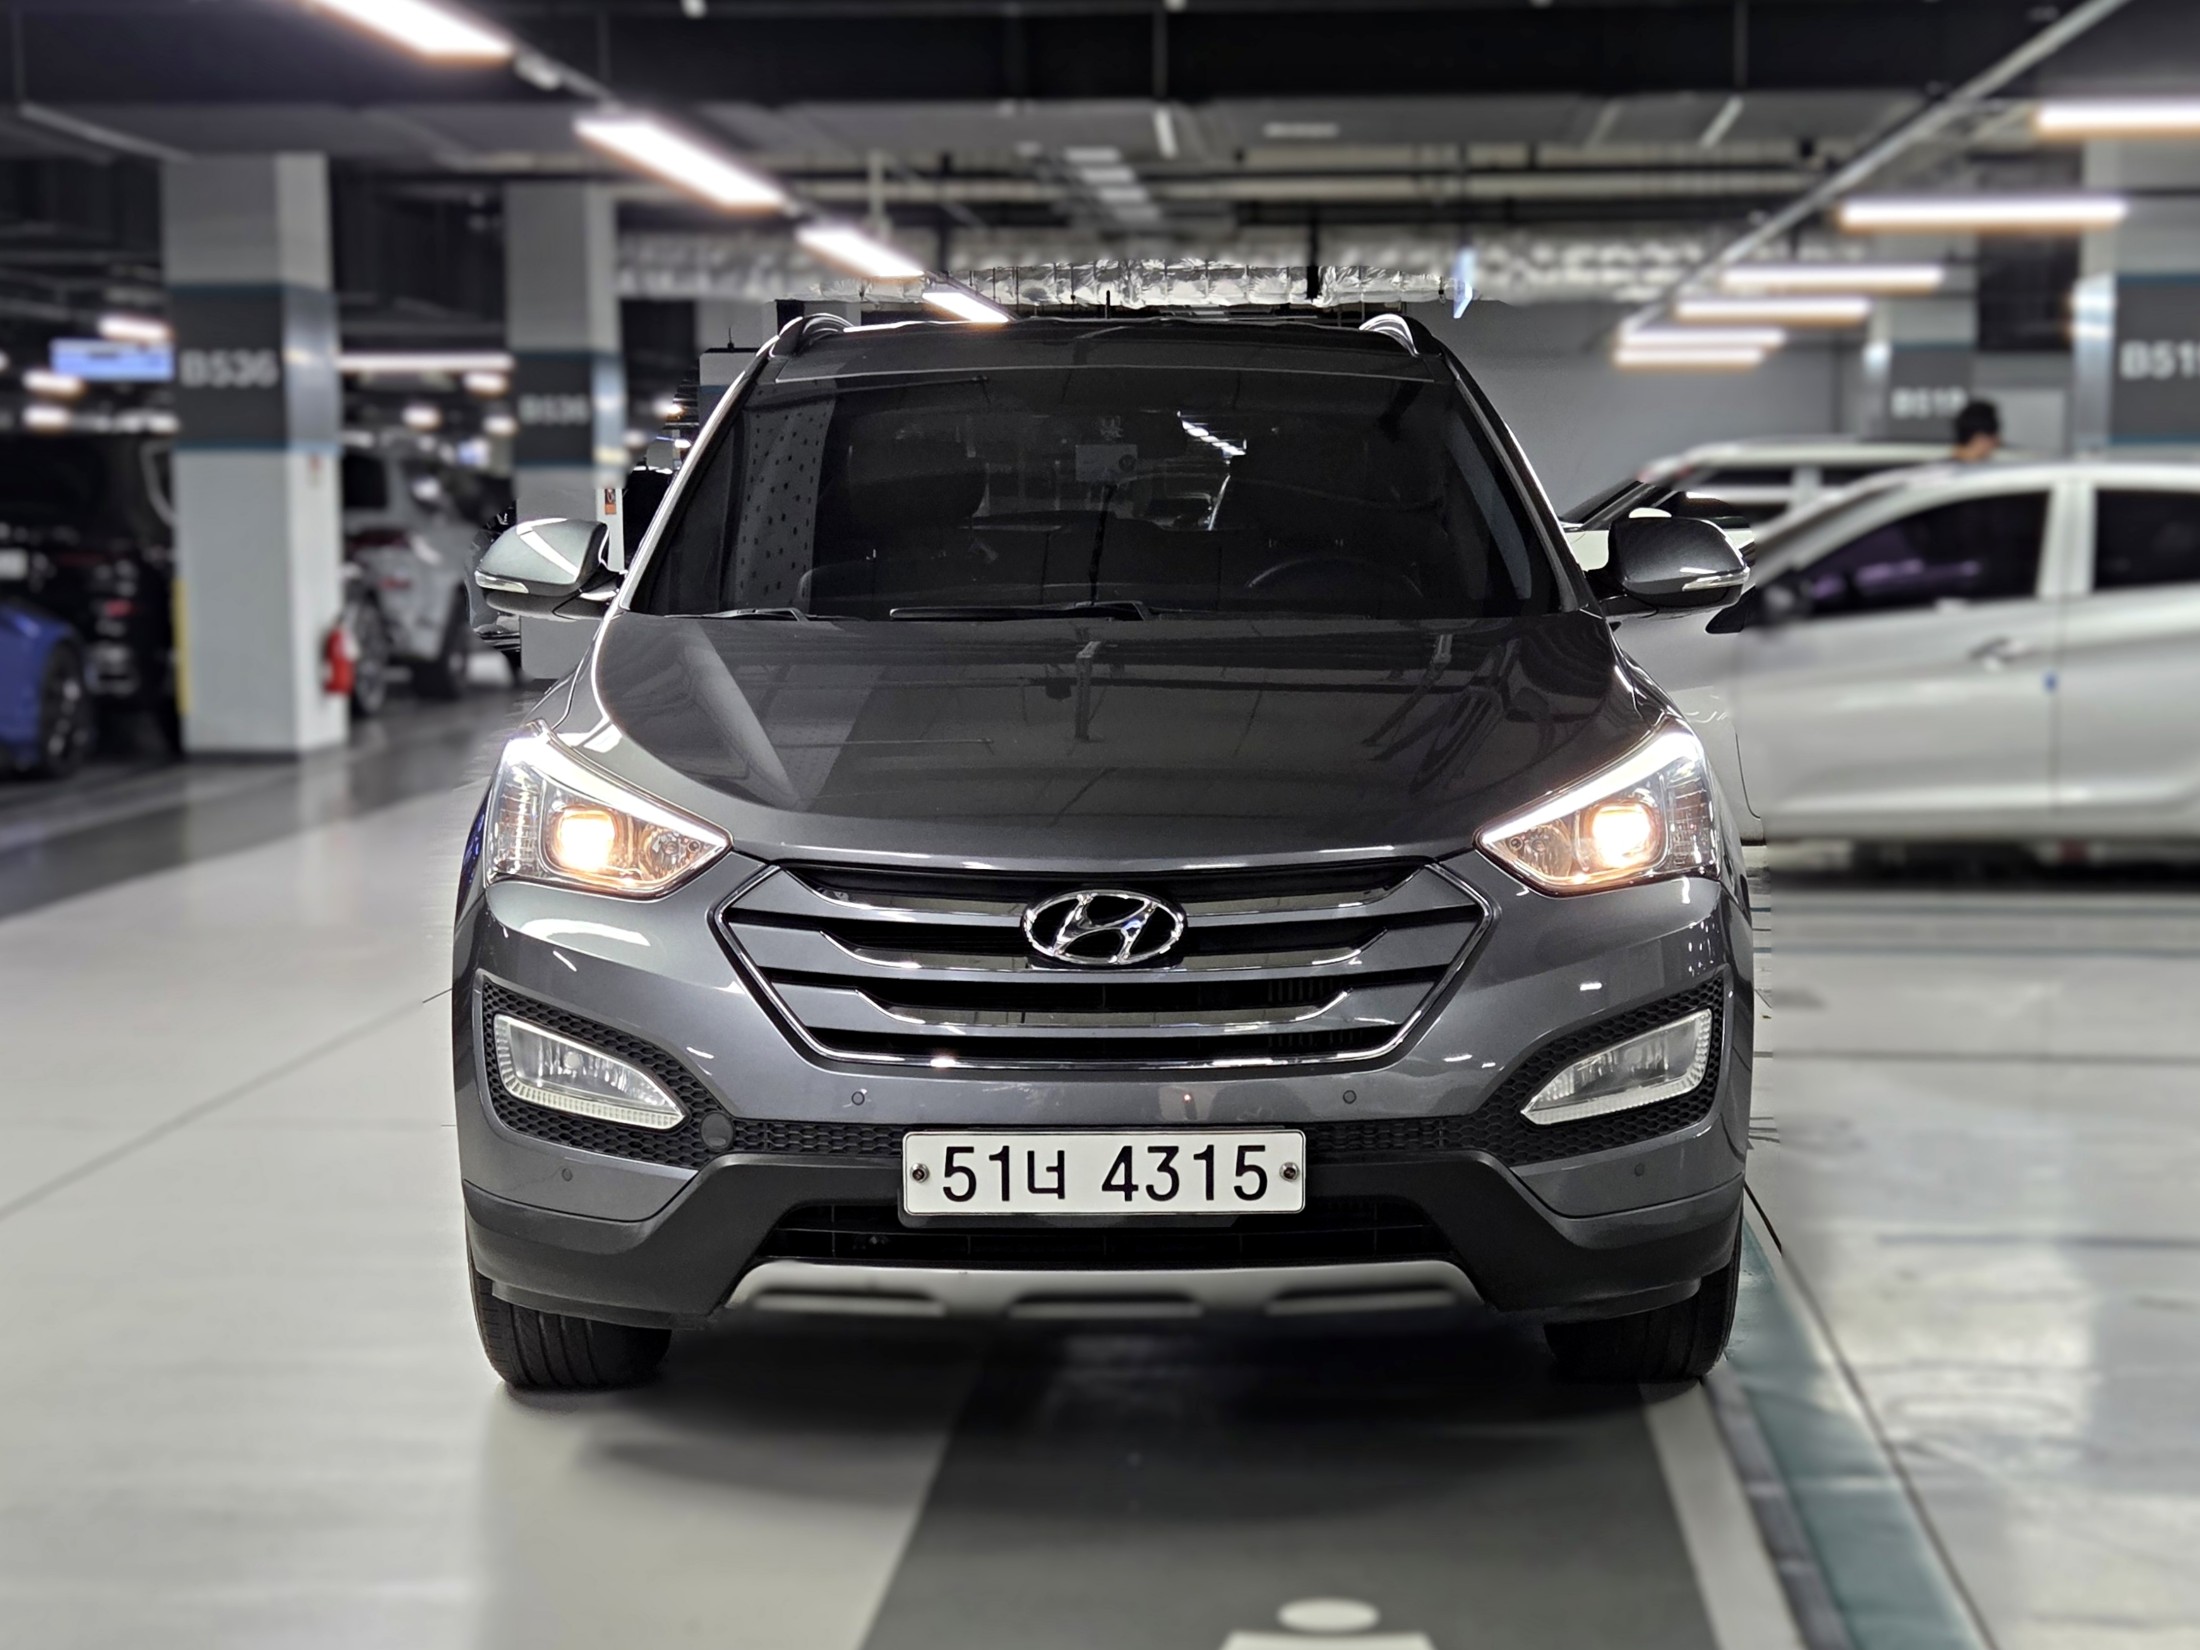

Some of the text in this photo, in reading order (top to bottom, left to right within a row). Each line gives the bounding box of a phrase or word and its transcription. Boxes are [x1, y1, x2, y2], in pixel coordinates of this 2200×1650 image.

[2121, 340, 2200, 379] B51
[943, 1144, 1268, 1202] 51너 4315
